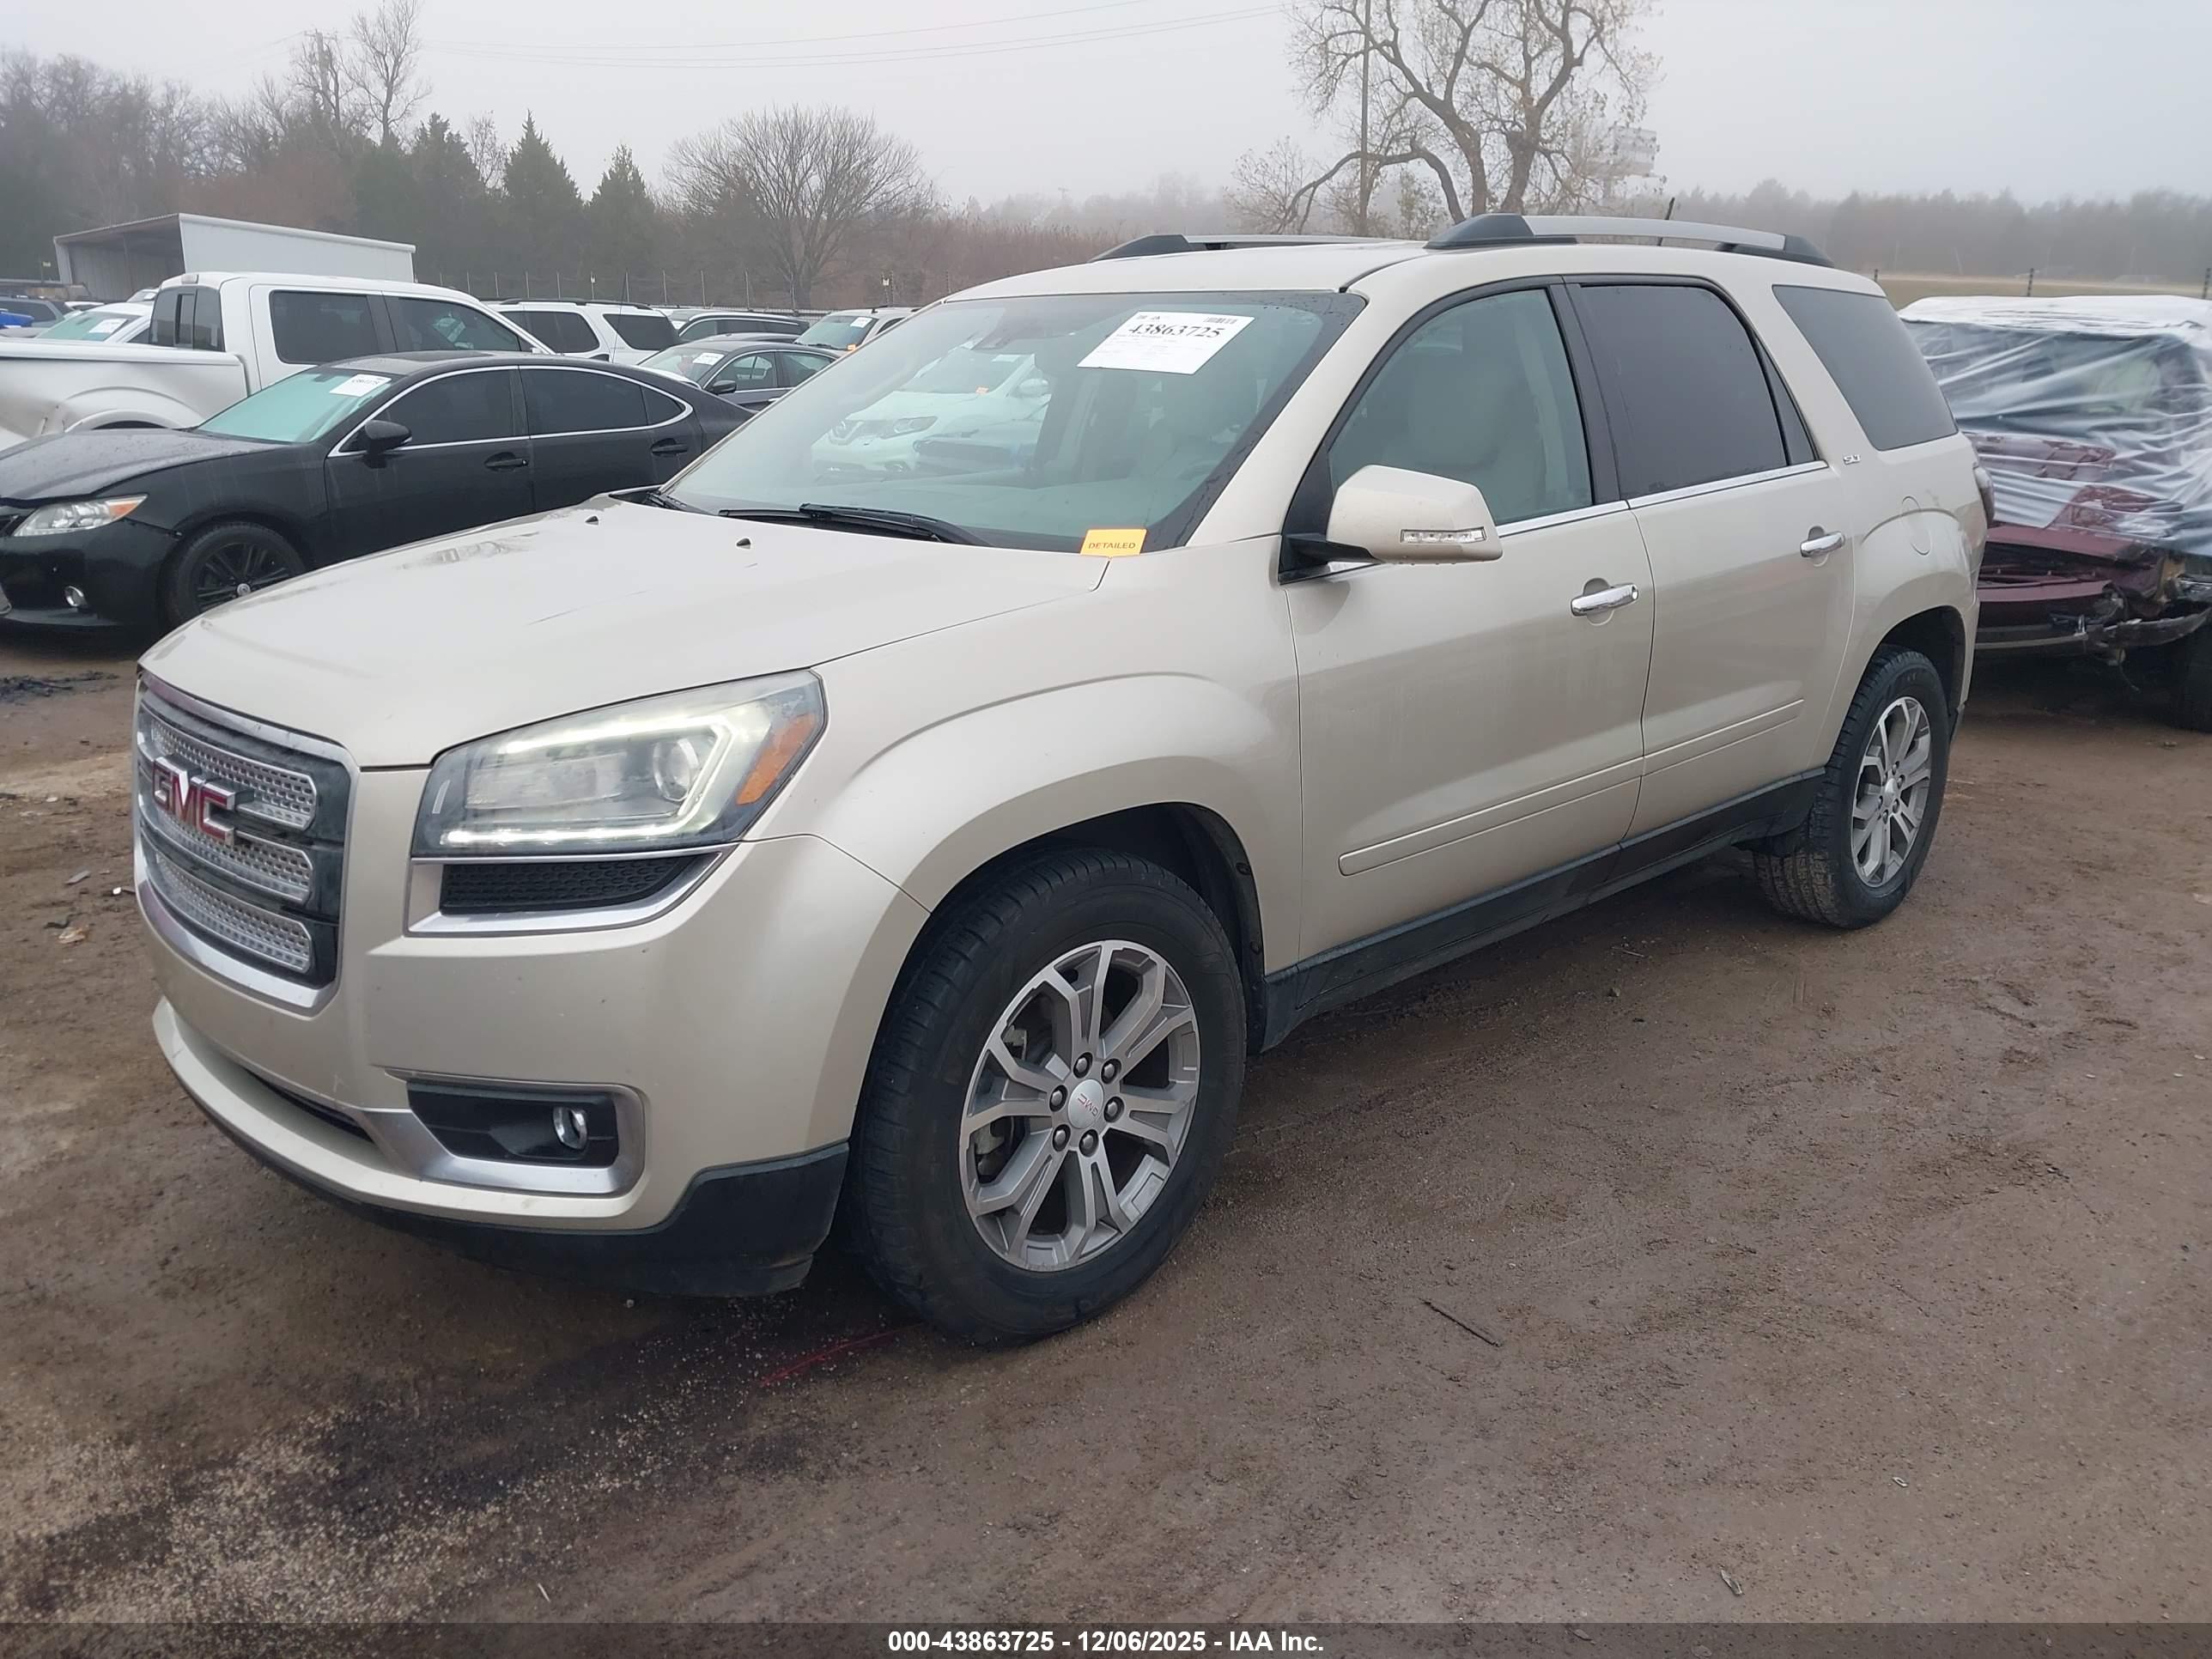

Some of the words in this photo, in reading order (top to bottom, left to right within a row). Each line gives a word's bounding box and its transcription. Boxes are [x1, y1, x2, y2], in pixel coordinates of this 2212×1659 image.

[1128, 324, 1225, 338] 43863725
[152, 757, 235, 846] GMC
[1077, 1092, 1099, 1117] GMC
